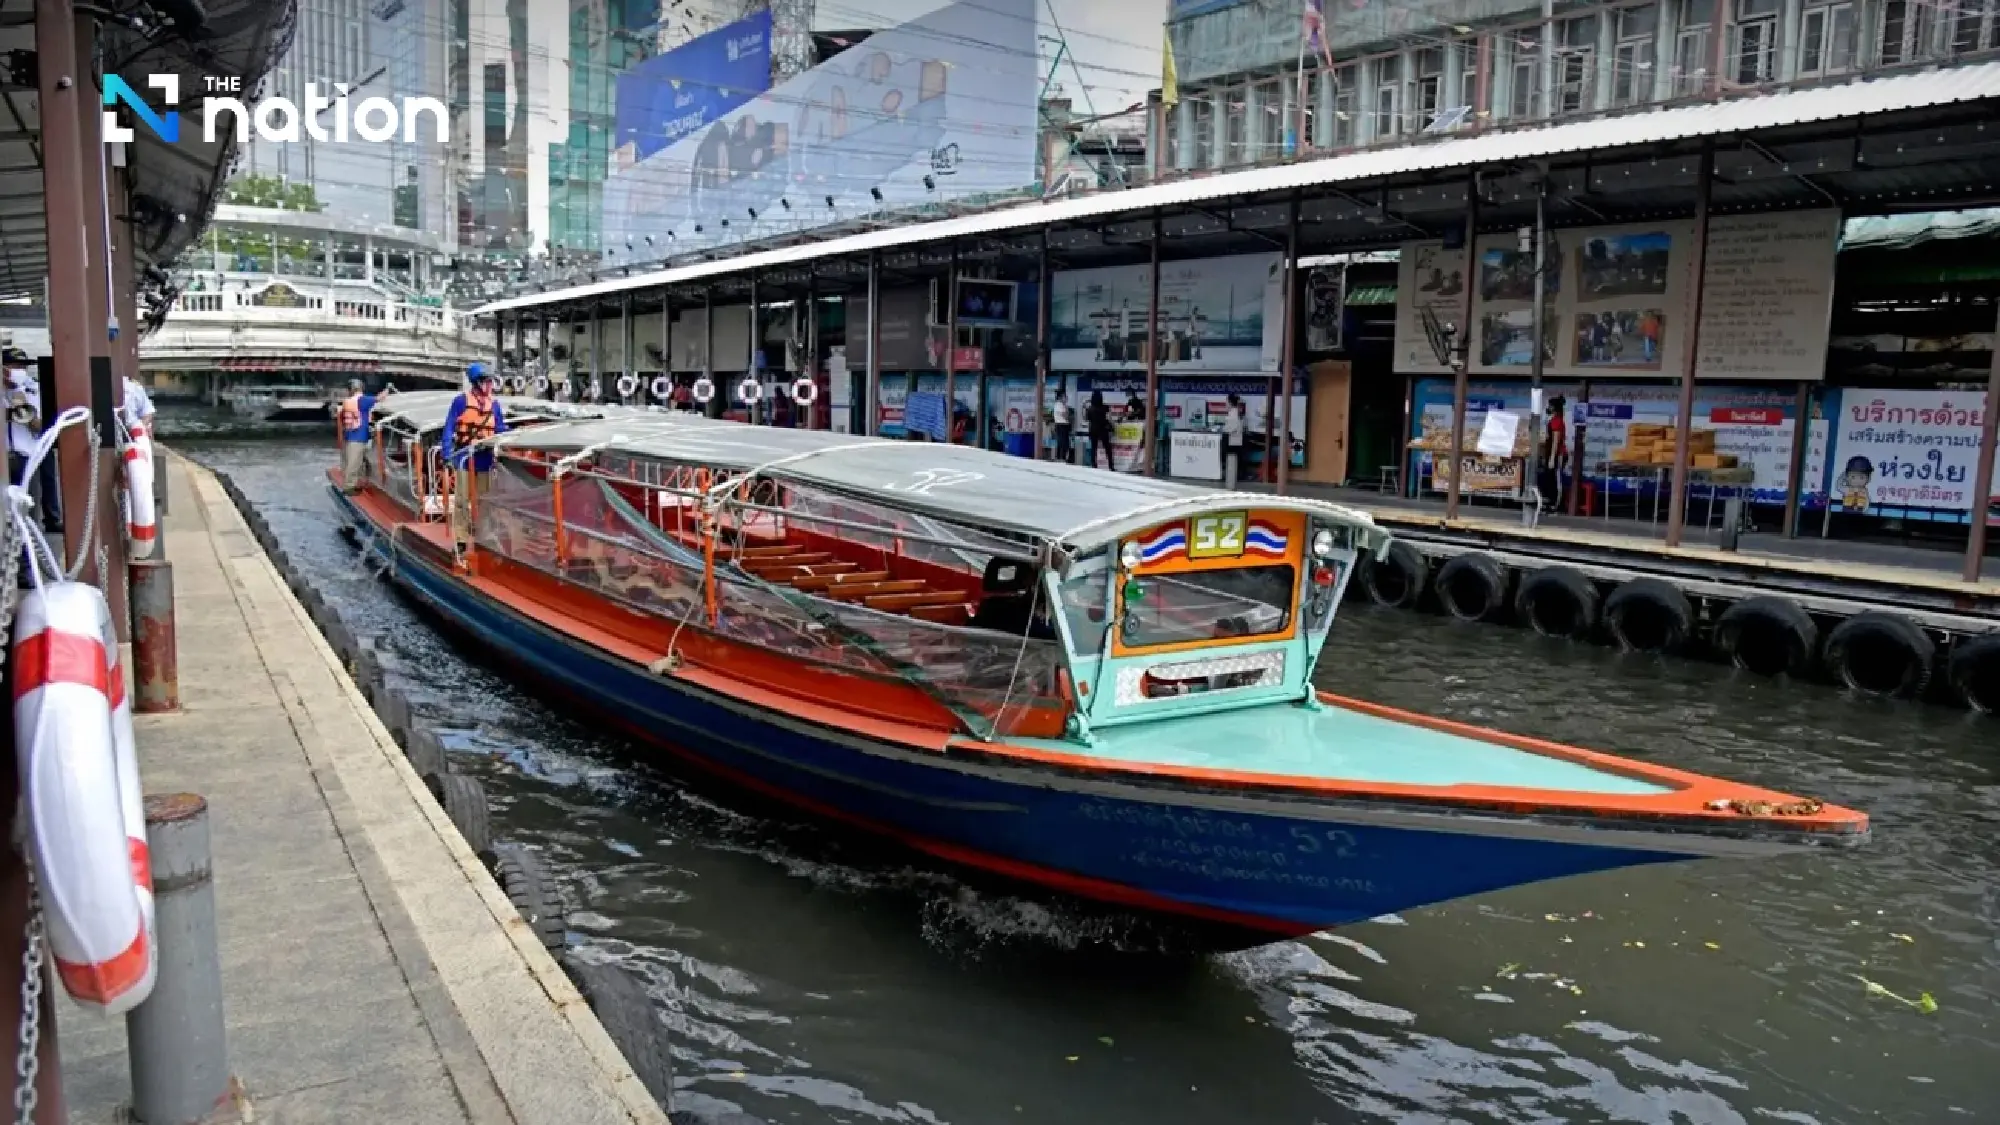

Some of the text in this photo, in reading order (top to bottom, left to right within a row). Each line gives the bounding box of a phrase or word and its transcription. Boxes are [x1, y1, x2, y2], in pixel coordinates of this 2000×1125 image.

[1852, 398, 1987, 427] บริการด้วย
[1878, 449, 1966, 483] ห่วงใย
[1195, 518, 1241, 550] 52
[1289, 825, 1358, 858] 52
